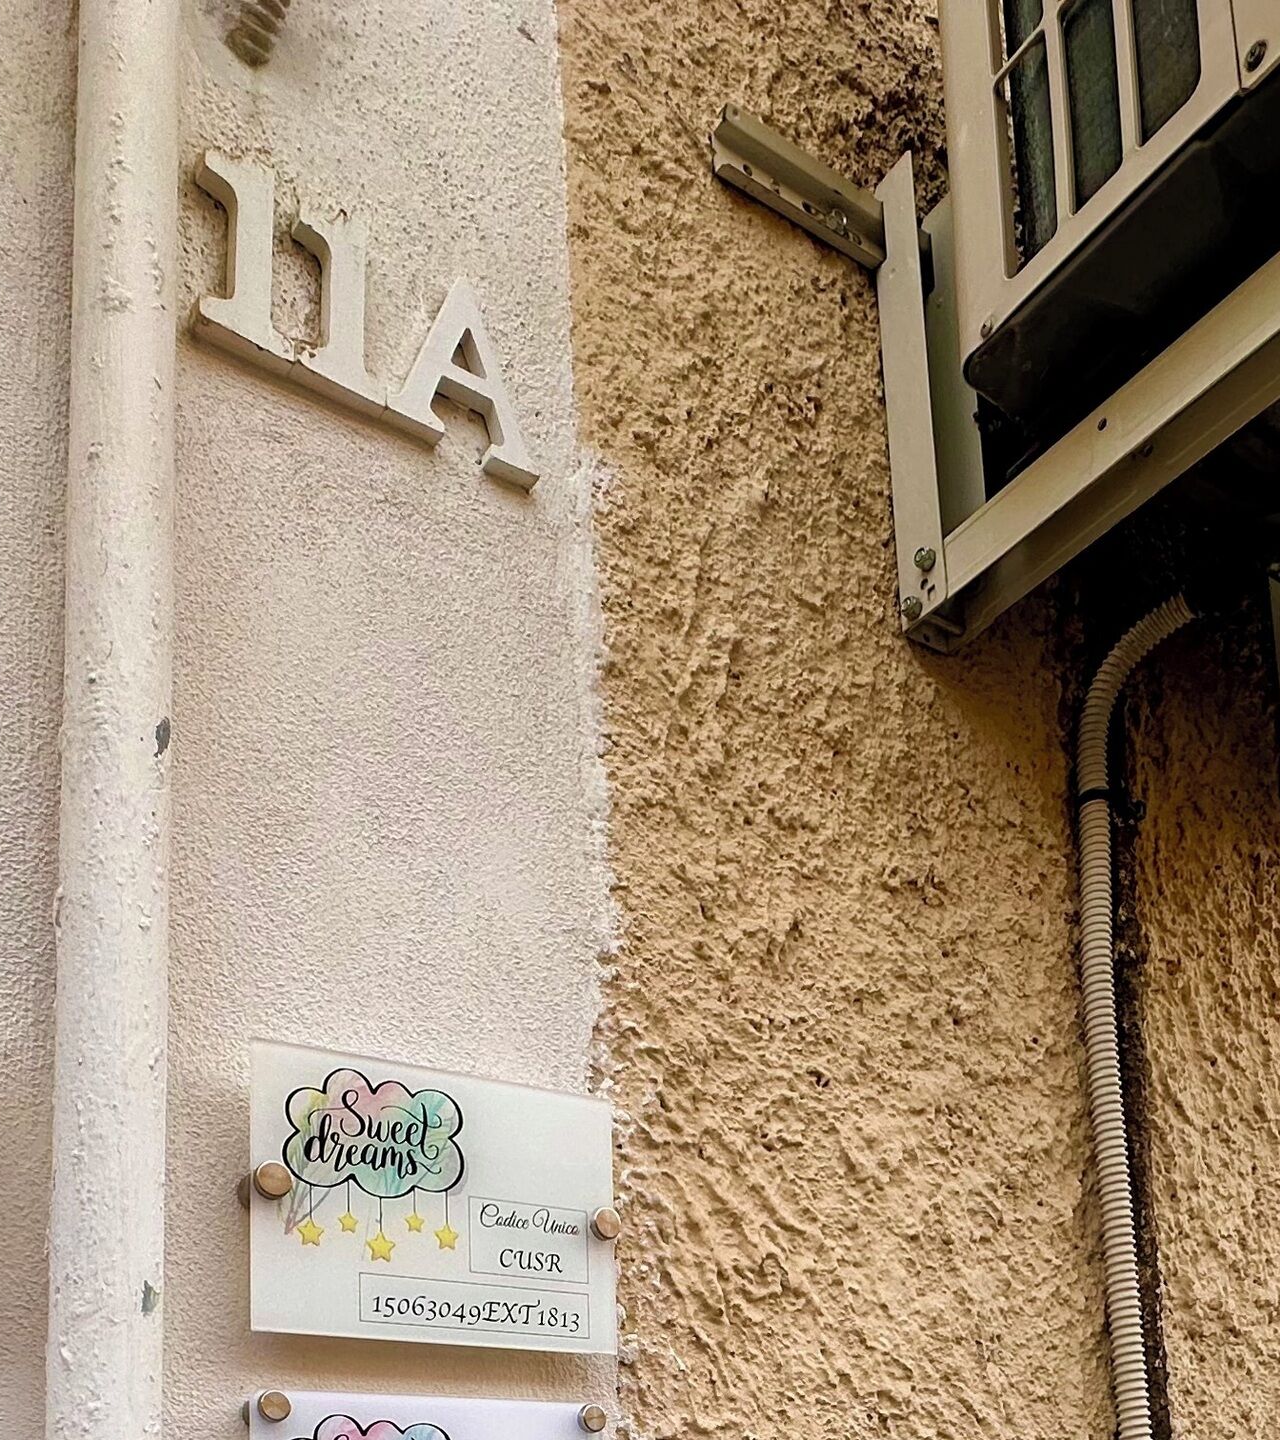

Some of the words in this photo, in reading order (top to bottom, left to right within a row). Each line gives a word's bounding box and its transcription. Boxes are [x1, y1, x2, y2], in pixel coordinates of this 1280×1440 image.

[195, 150, 540, 494] 11A
[304, 1113, 441, 1179] dreams
[309, 1089, 443, 1159] Sweet
[480, 1202, 529, 1230] Codice
[533, 1208, 579, 1235] Unico
[500, 1248, 563, 1273] CUSR
[372, 1295, 580, 1332] 15063049EXT1813
